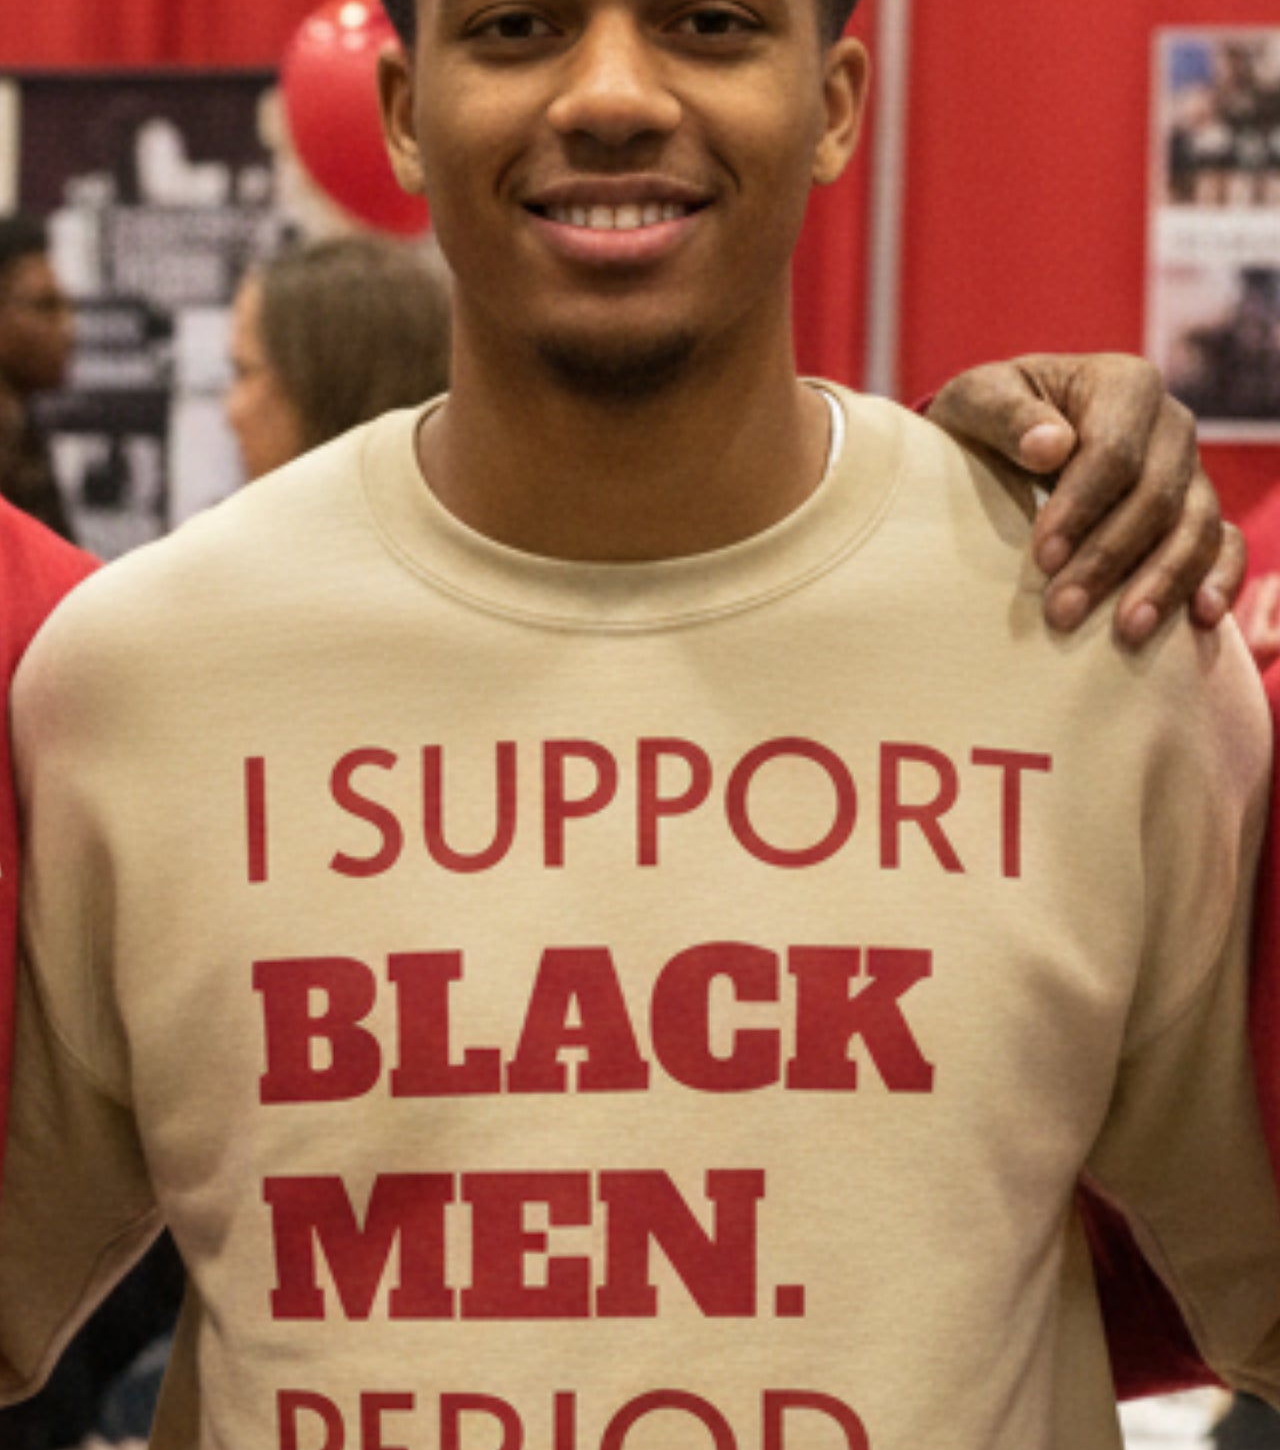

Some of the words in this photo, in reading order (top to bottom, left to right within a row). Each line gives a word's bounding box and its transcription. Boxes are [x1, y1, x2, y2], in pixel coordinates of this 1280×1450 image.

[244, 756, 268, 883] I
[328, 737, 1053, 878] SUPPORT
[252, 940, 935, 1105] BLACK
[263, 1168, 805, 1321] MEN.
